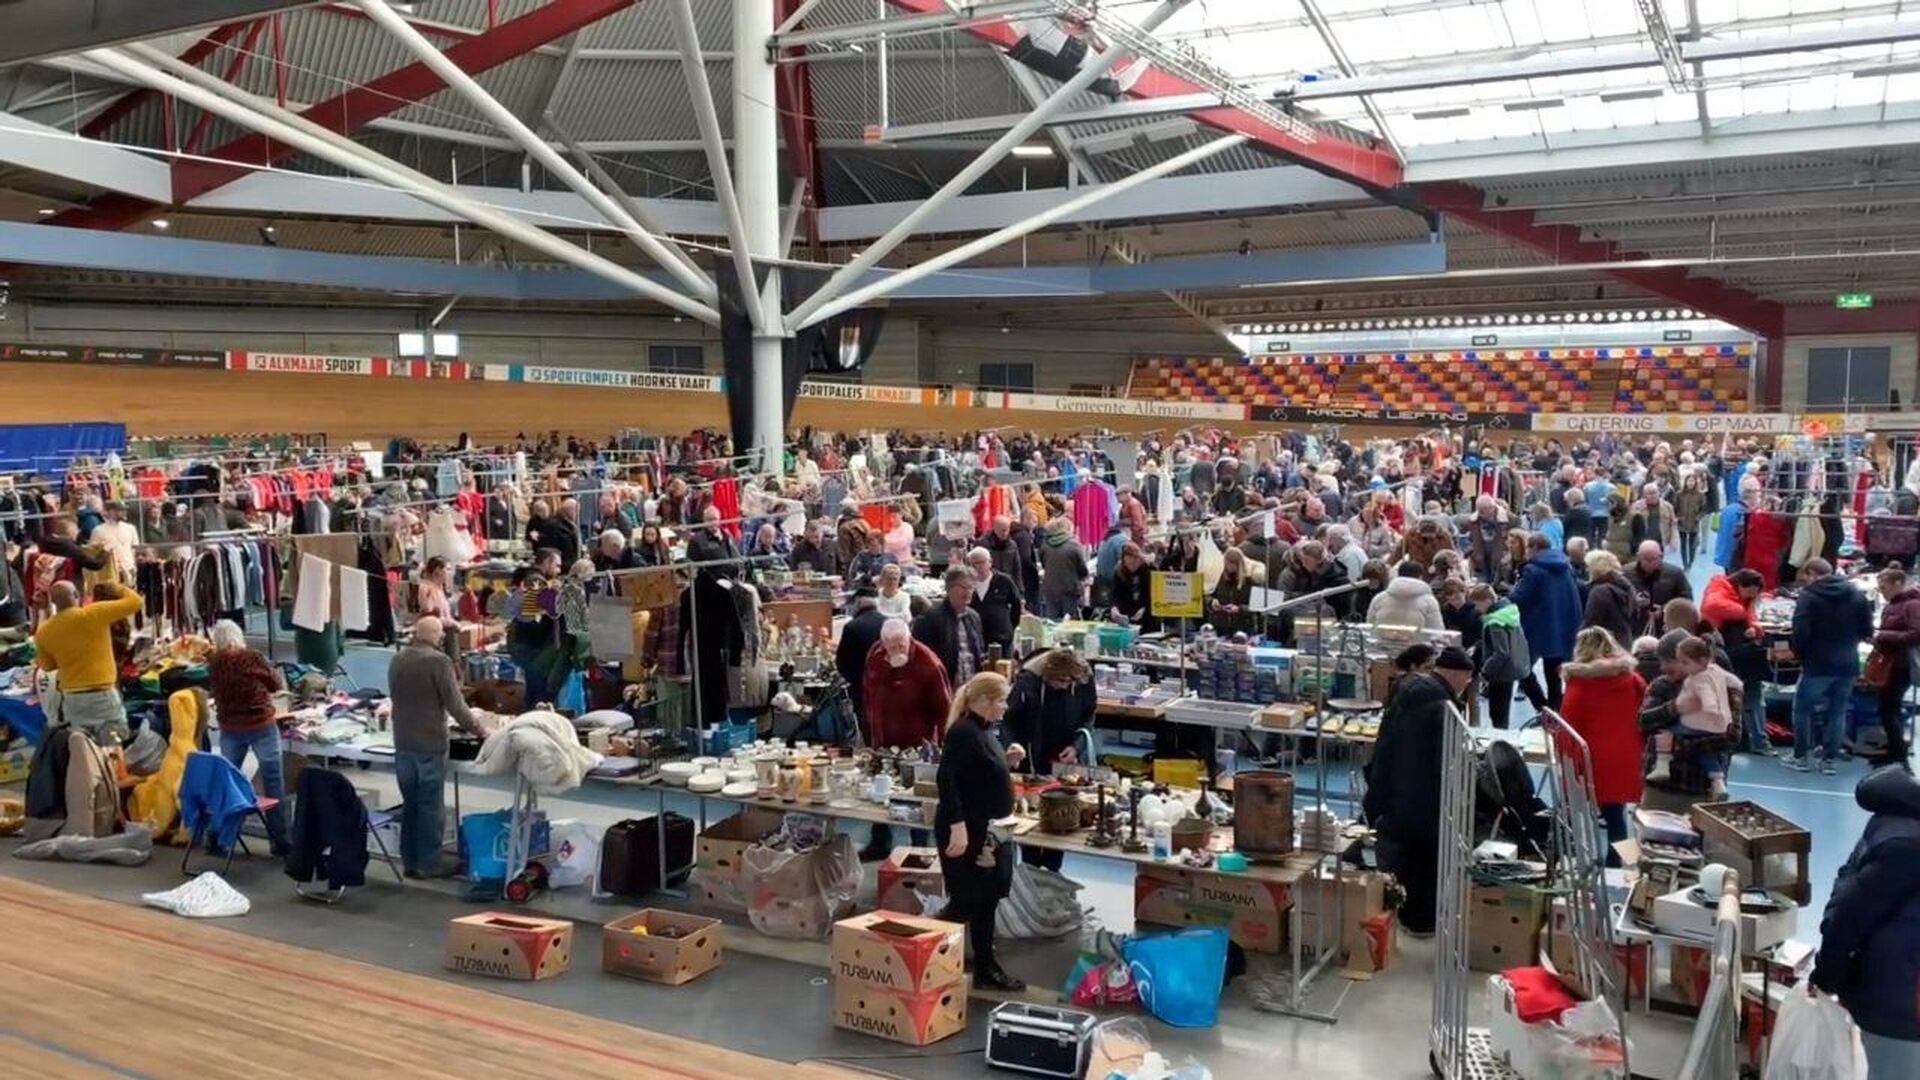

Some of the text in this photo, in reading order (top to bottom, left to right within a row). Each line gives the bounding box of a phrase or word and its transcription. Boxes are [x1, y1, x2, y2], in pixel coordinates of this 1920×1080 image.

[325, 359, 362, 372] SPORT
[543, 369, 712, 391] SPORTCOMPLEX HOORNSE VAART
[1055, 398, 1194, 417] Gemeente Alkmaar
[1567, 416, 1654, 431] CATERING
[1695, 417, 1720, 431] OP
[1726, 417, 1777, 431] MAAT
[1201, 887, 1257, 908] TURBANA
[453, 955, 512, 976] TURBANA
[839, 961, 896, 986] TURBANA
[842, 1011, 899, 1037] TURBANA
